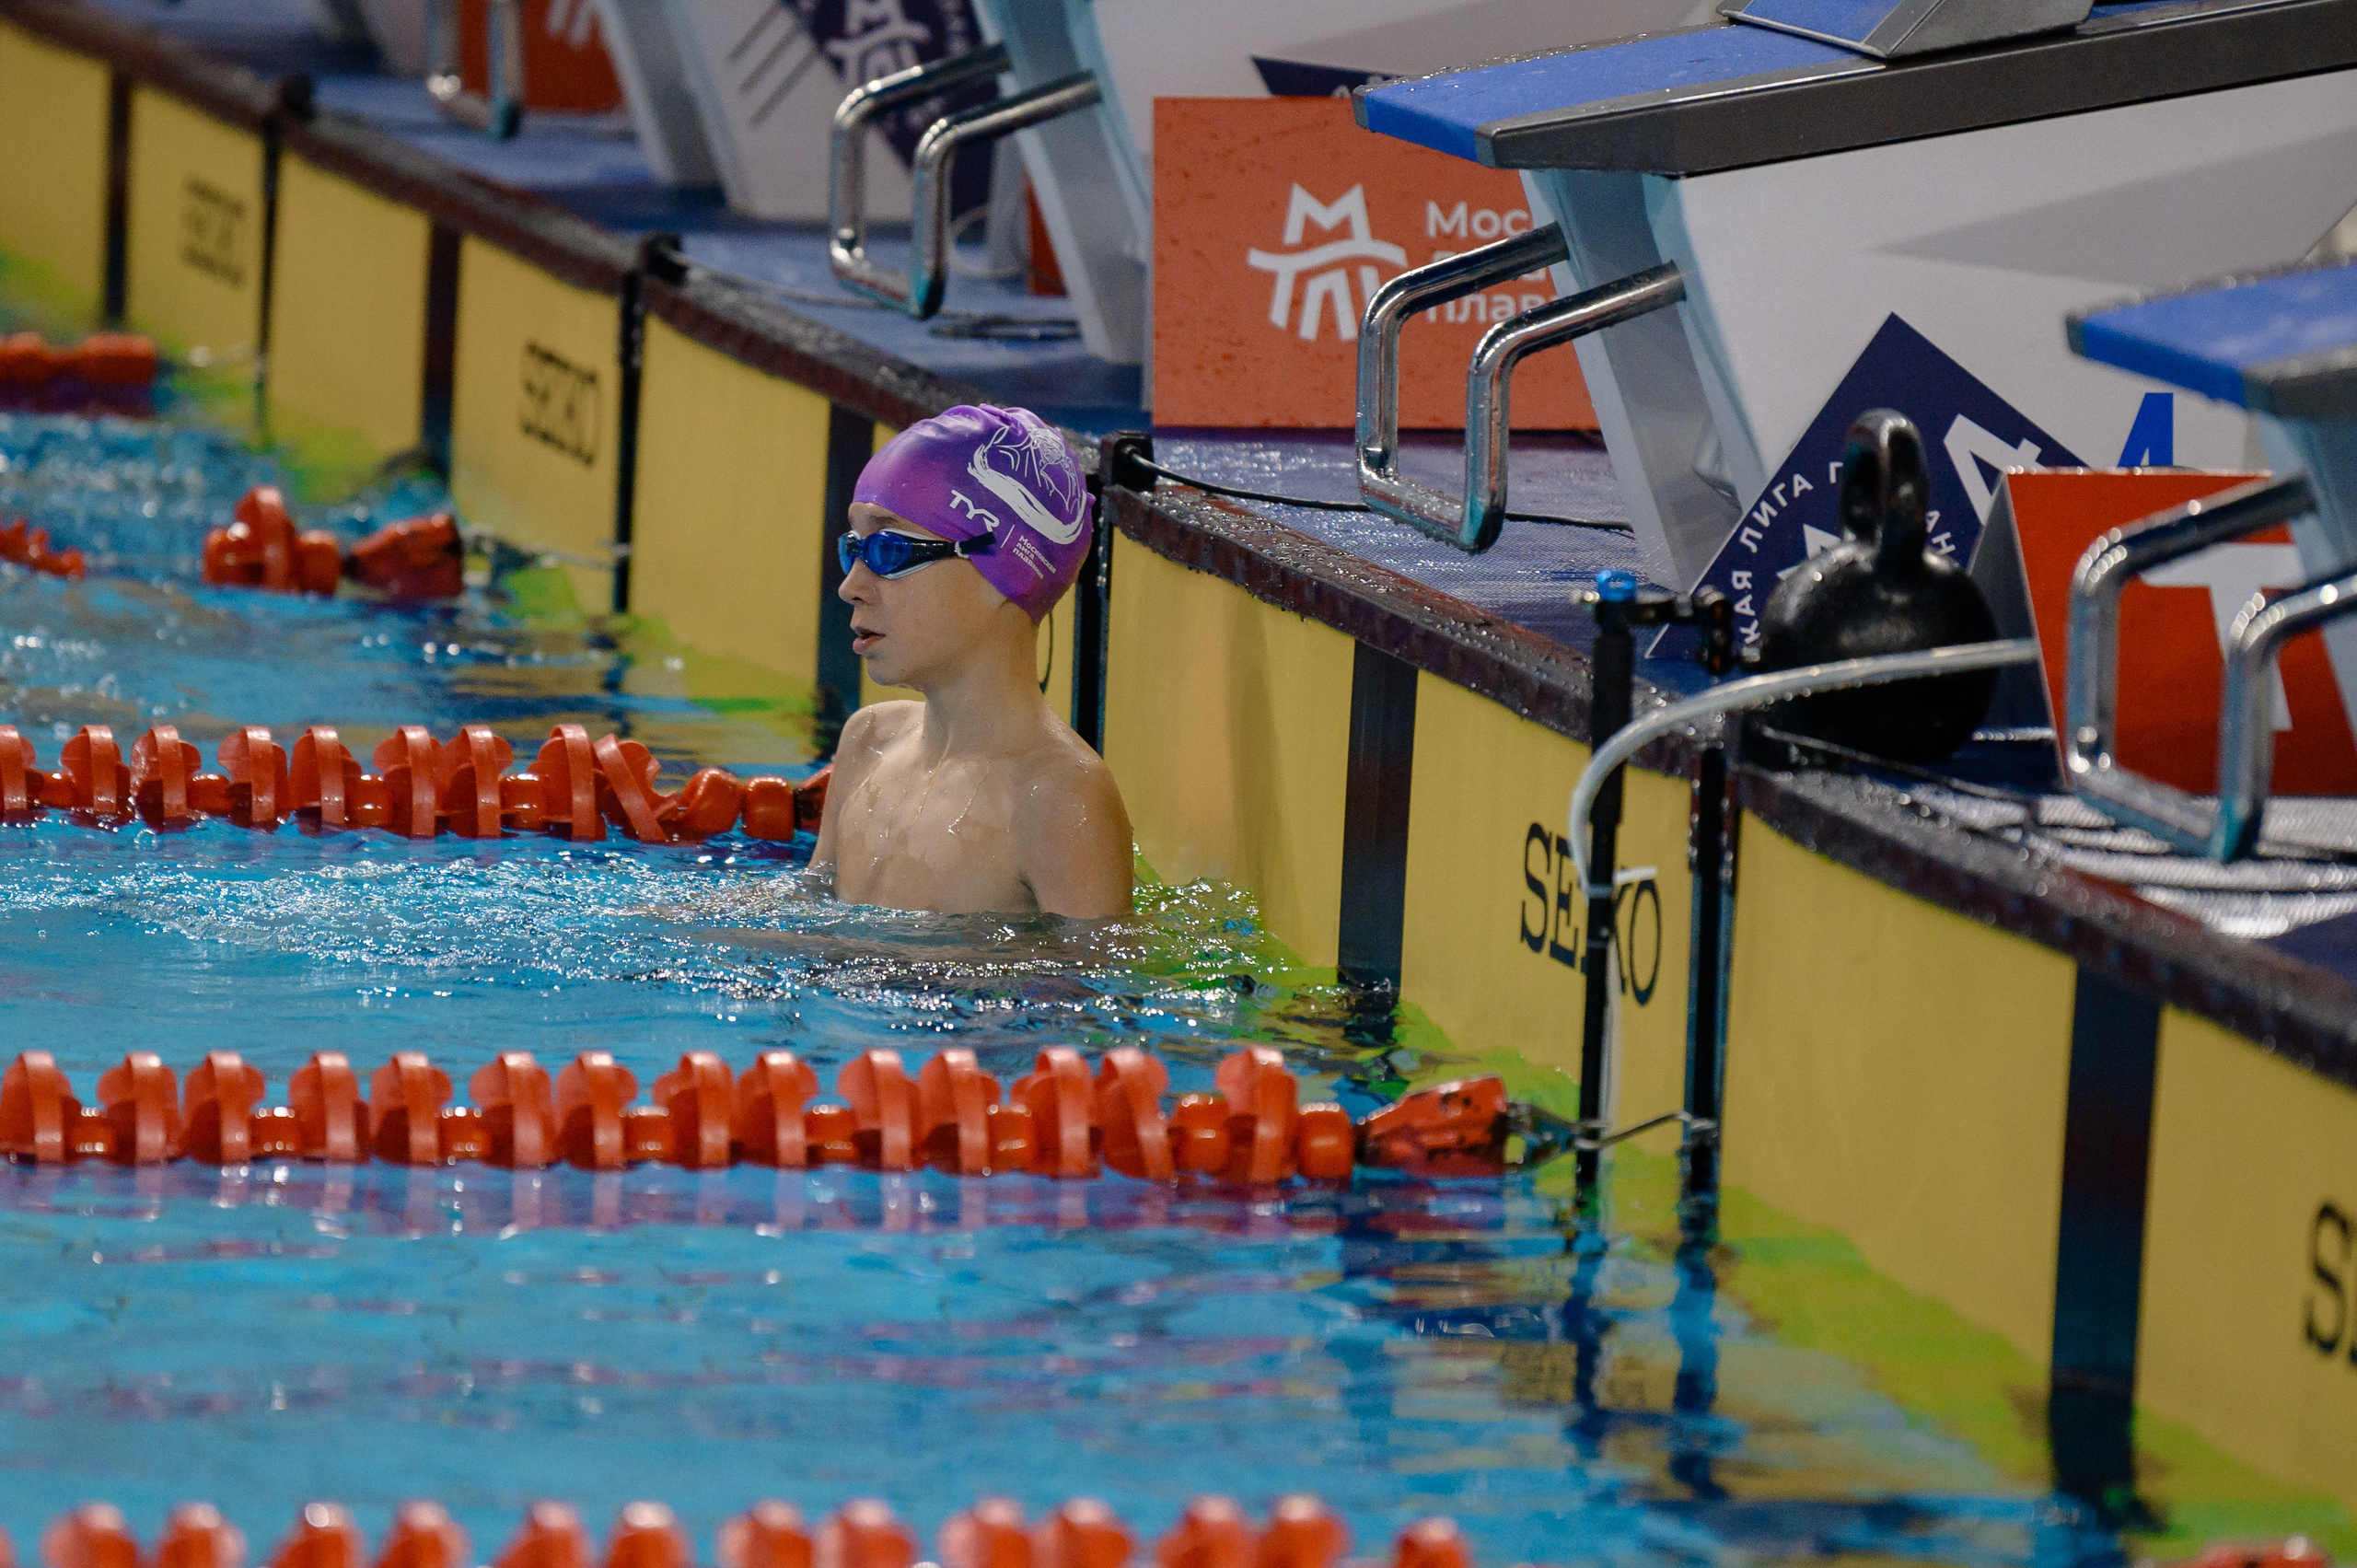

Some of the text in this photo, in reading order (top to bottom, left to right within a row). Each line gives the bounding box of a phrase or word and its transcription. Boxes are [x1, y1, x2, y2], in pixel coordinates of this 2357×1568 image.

[1426, 200, 1529, 238] Мос
[949, 489, 1001, 533] TYR
[1739, 473, 1814, 554] ЛИГА
[1520, 822, 1662, 1007] SEKO
